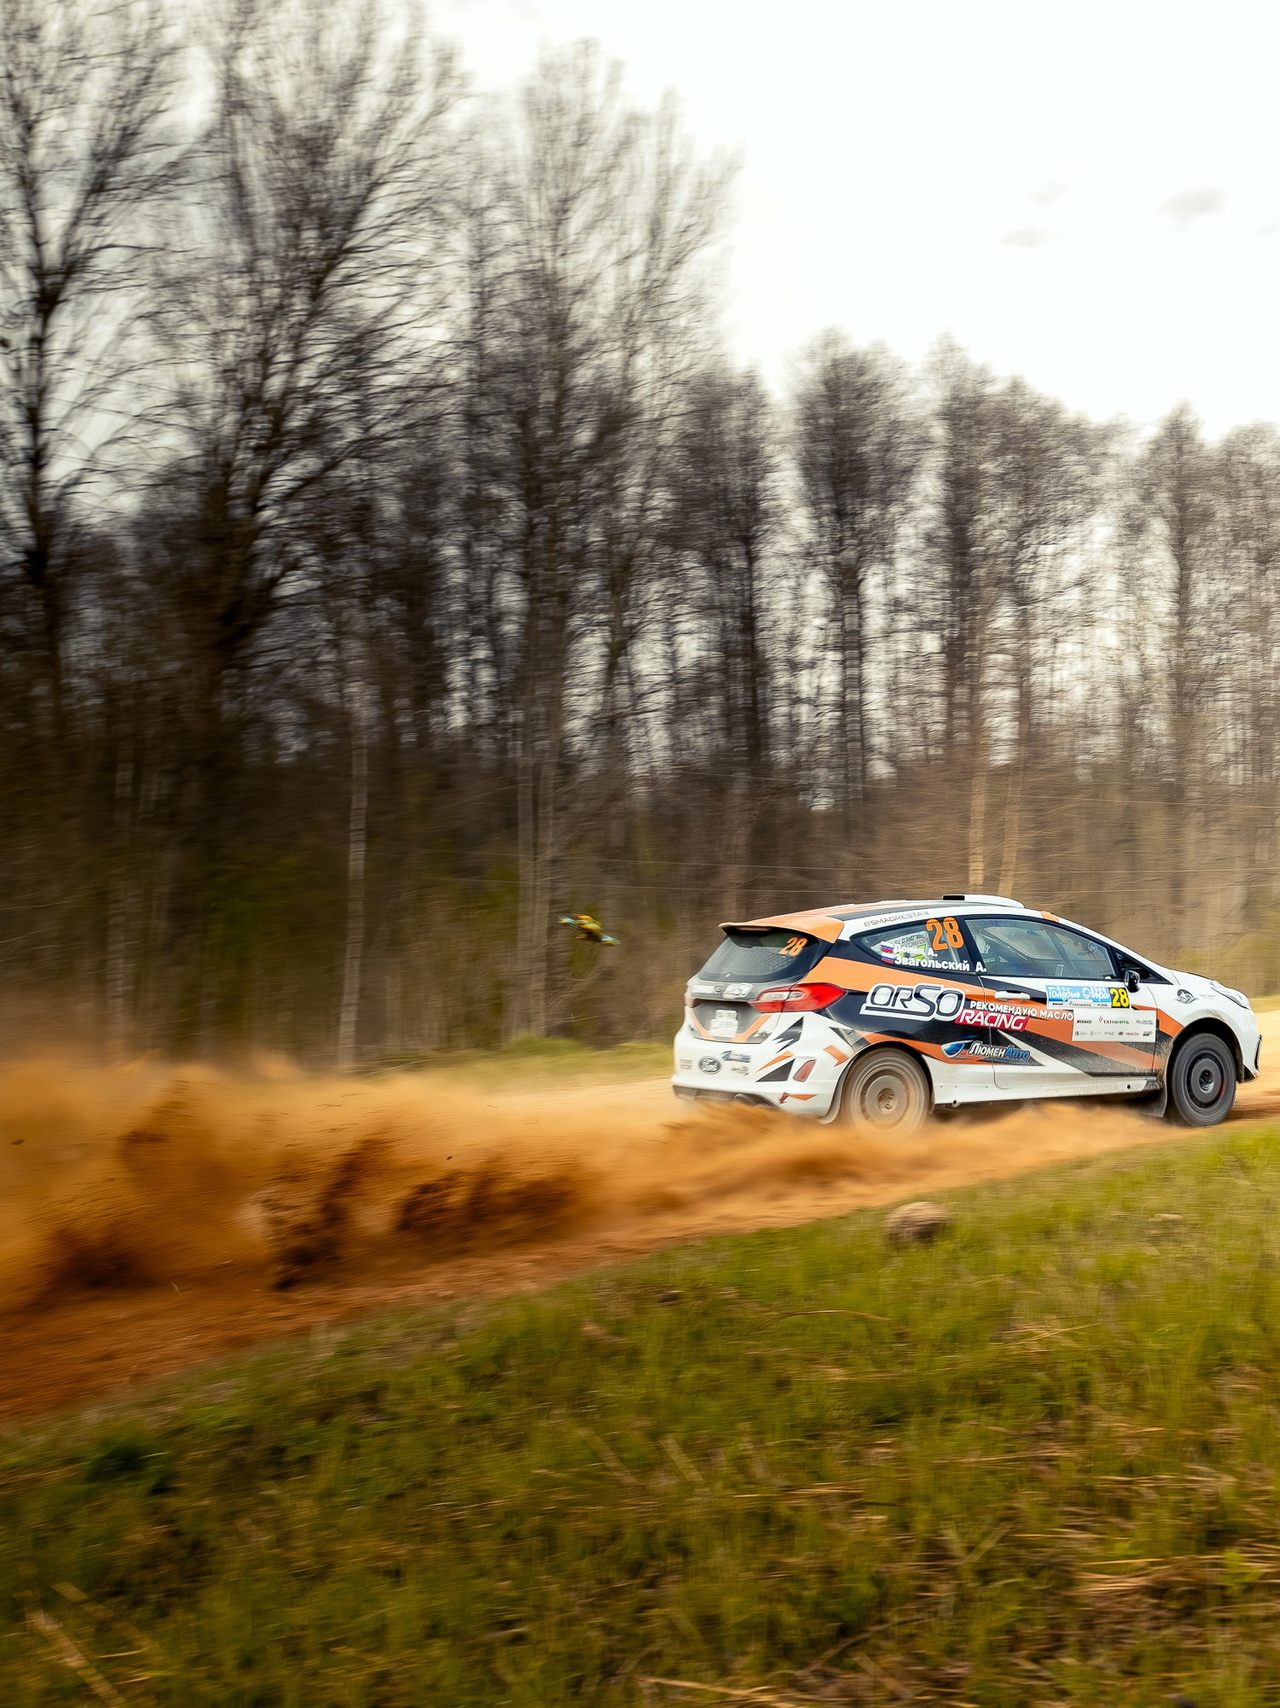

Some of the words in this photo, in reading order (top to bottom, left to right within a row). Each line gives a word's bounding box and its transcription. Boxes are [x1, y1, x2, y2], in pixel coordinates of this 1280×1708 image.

[926, 917, 964, 951] 28
[779, 937, 808, 956] 28
[894, 943, 926, 957] Донец
[928, 947, 938, 957] А.
[894, 955, 970, 972] Звагольский
[975, 961, 987, 972] А.
[1110, 988, 1130, 1007] 28
[959, 1010, 1026, 1030] RACING
[970, 1001, 1038, 1017] РЕКОМЕНДУЮ
[1039, 1009, 1074, 1021] МАСЛО
